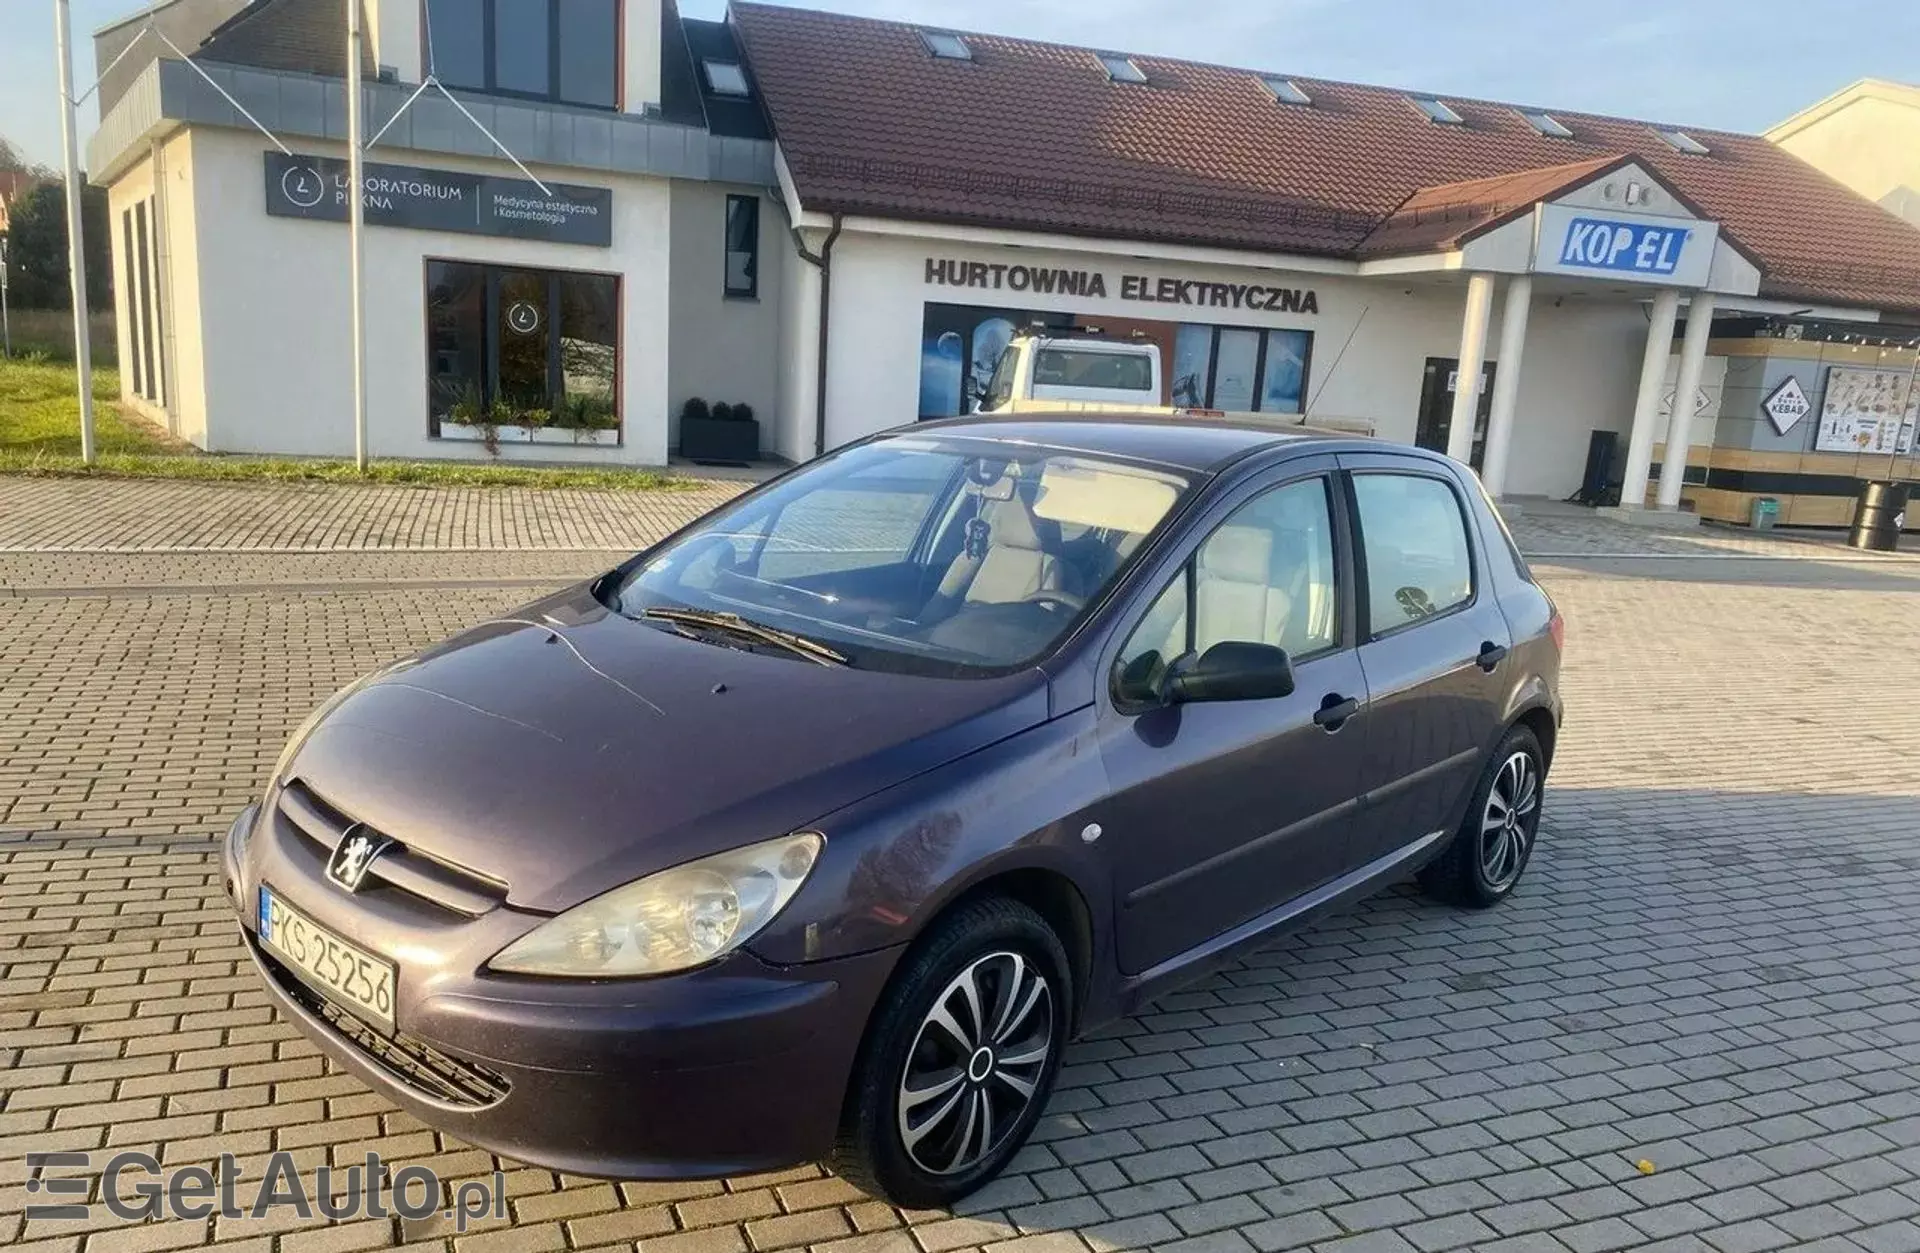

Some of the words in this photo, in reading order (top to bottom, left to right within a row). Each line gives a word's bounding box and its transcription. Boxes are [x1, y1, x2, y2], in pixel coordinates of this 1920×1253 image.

[335, 190, 393, 210] PIKNA
[493, 195, 544, 211] Medycyna
[545, 200, 598, 217] estetyczna
[499, 207, 566, 224] Kosmetologia
[924, 257, 1107, 298] HURTOWNIA
[1121, 275, 1319, 315] ELEKTRYCZNA
[1771, 404, 1804, 415] KEBAB
[271, 902, 306, 963] PKS
[313, 934, 390, 1014] 25256
